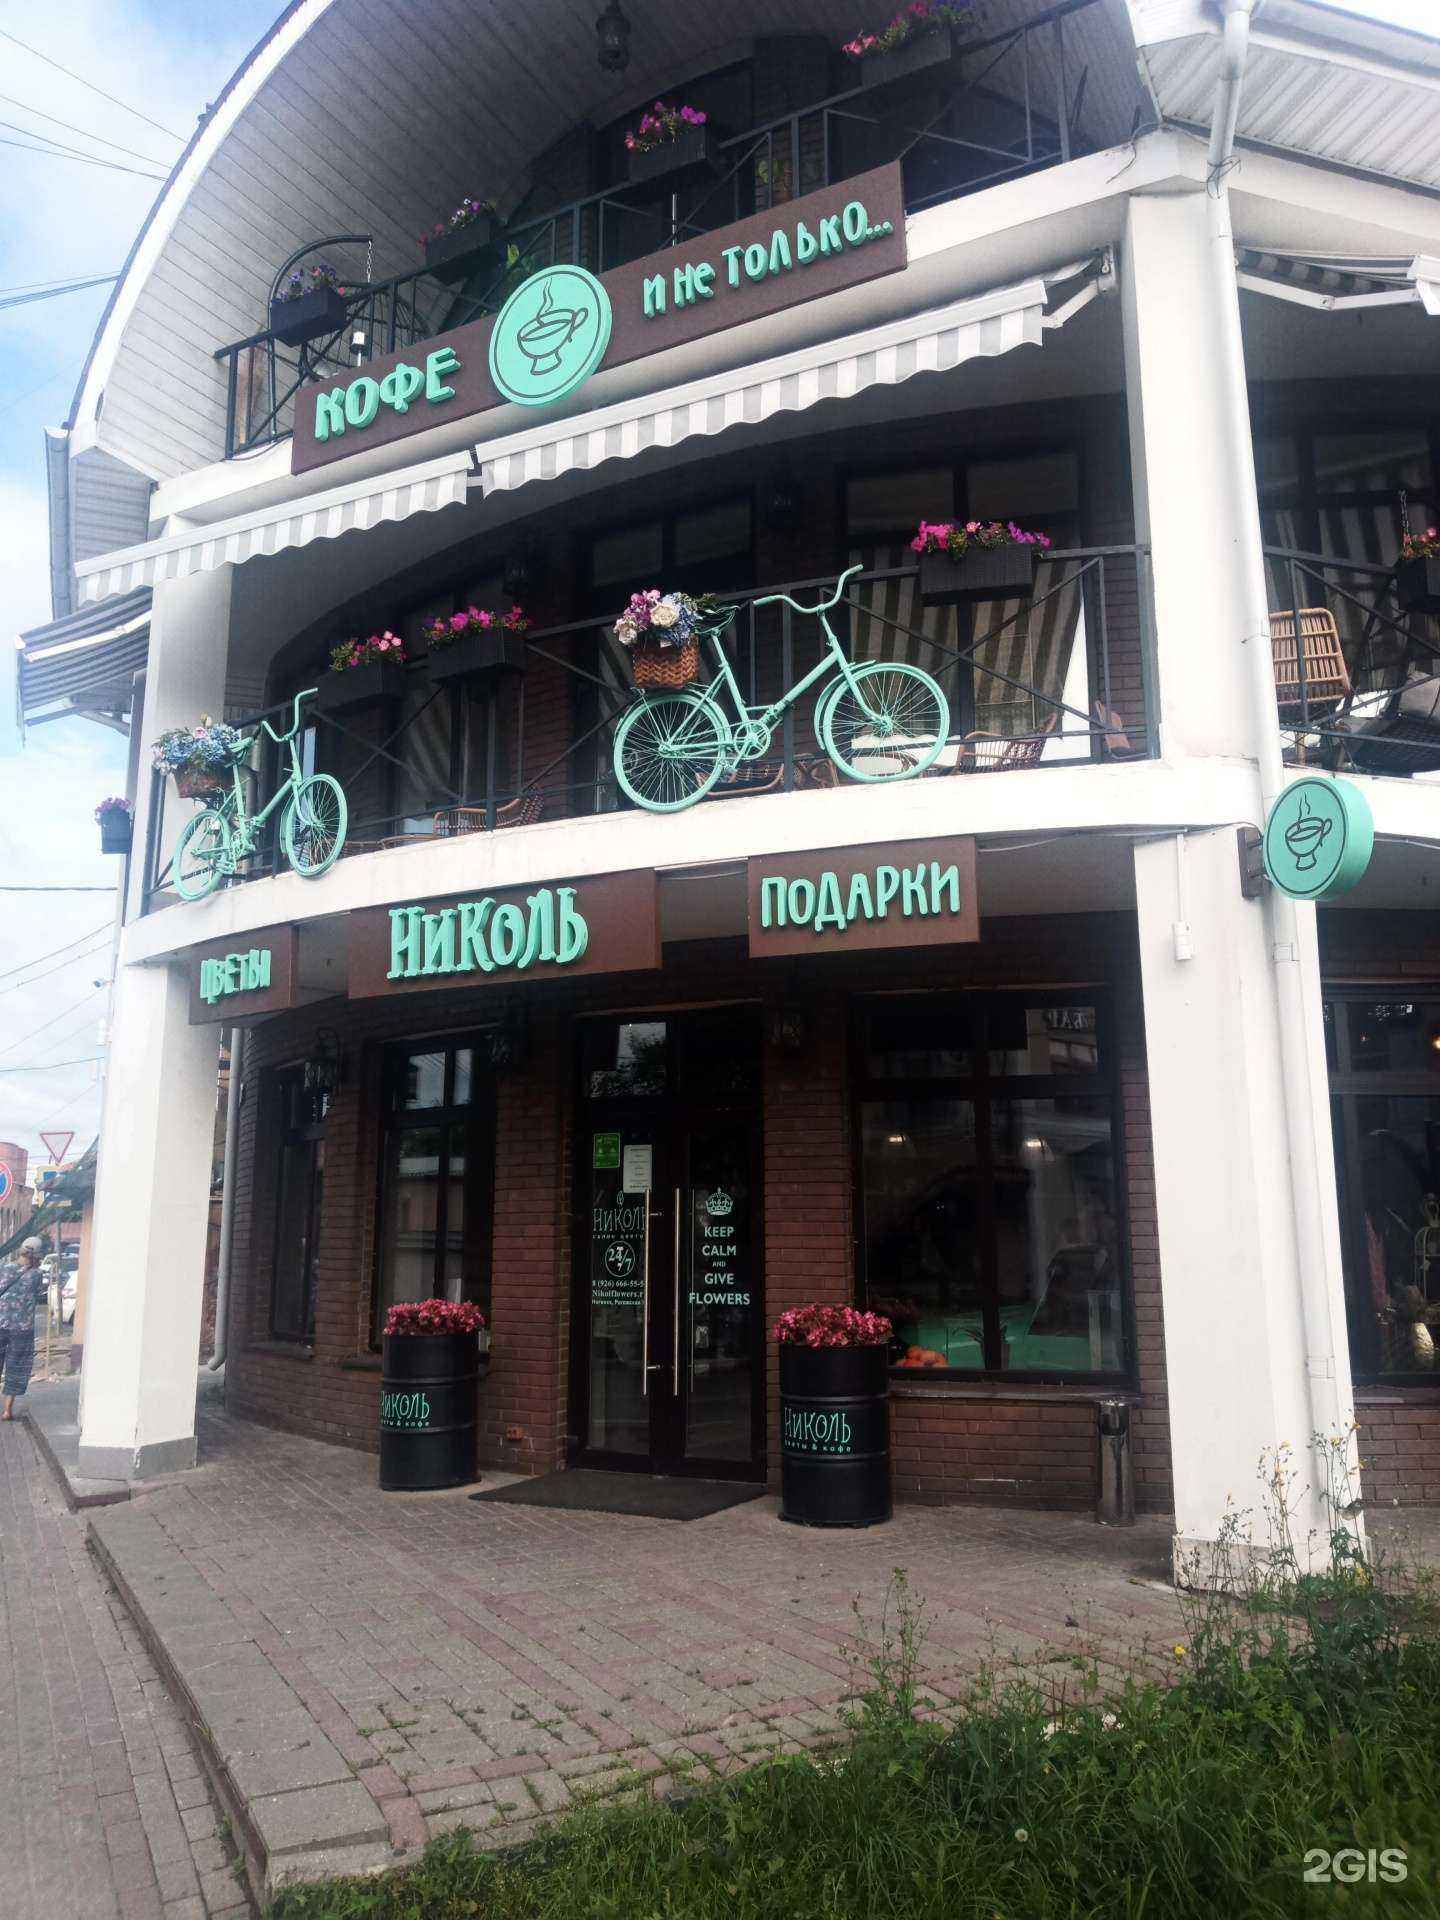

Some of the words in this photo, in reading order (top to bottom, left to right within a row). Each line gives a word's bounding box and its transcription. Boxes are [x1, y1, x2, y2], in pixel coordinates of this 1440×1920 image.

[315, 347, 461, 441] КОФЕ
[761, 861, 961, 932] ПОДАРКИ
[386, 887, 589, 980] НИКОЛЬ
[200, 949, 271, 1003] ЦВЕТЫ
[704, 1226, 734, 1237] KEEP
[702, 1245, 737, 1256] CALM
[704, 1273, 735, 1285] GIVE
[592, 1289, 645, 1298] Nikolflowers.r
[688, 1292, 751, 1305] FLOWERS
[784, 1408, 851, 1443] НИКОЛЬ
